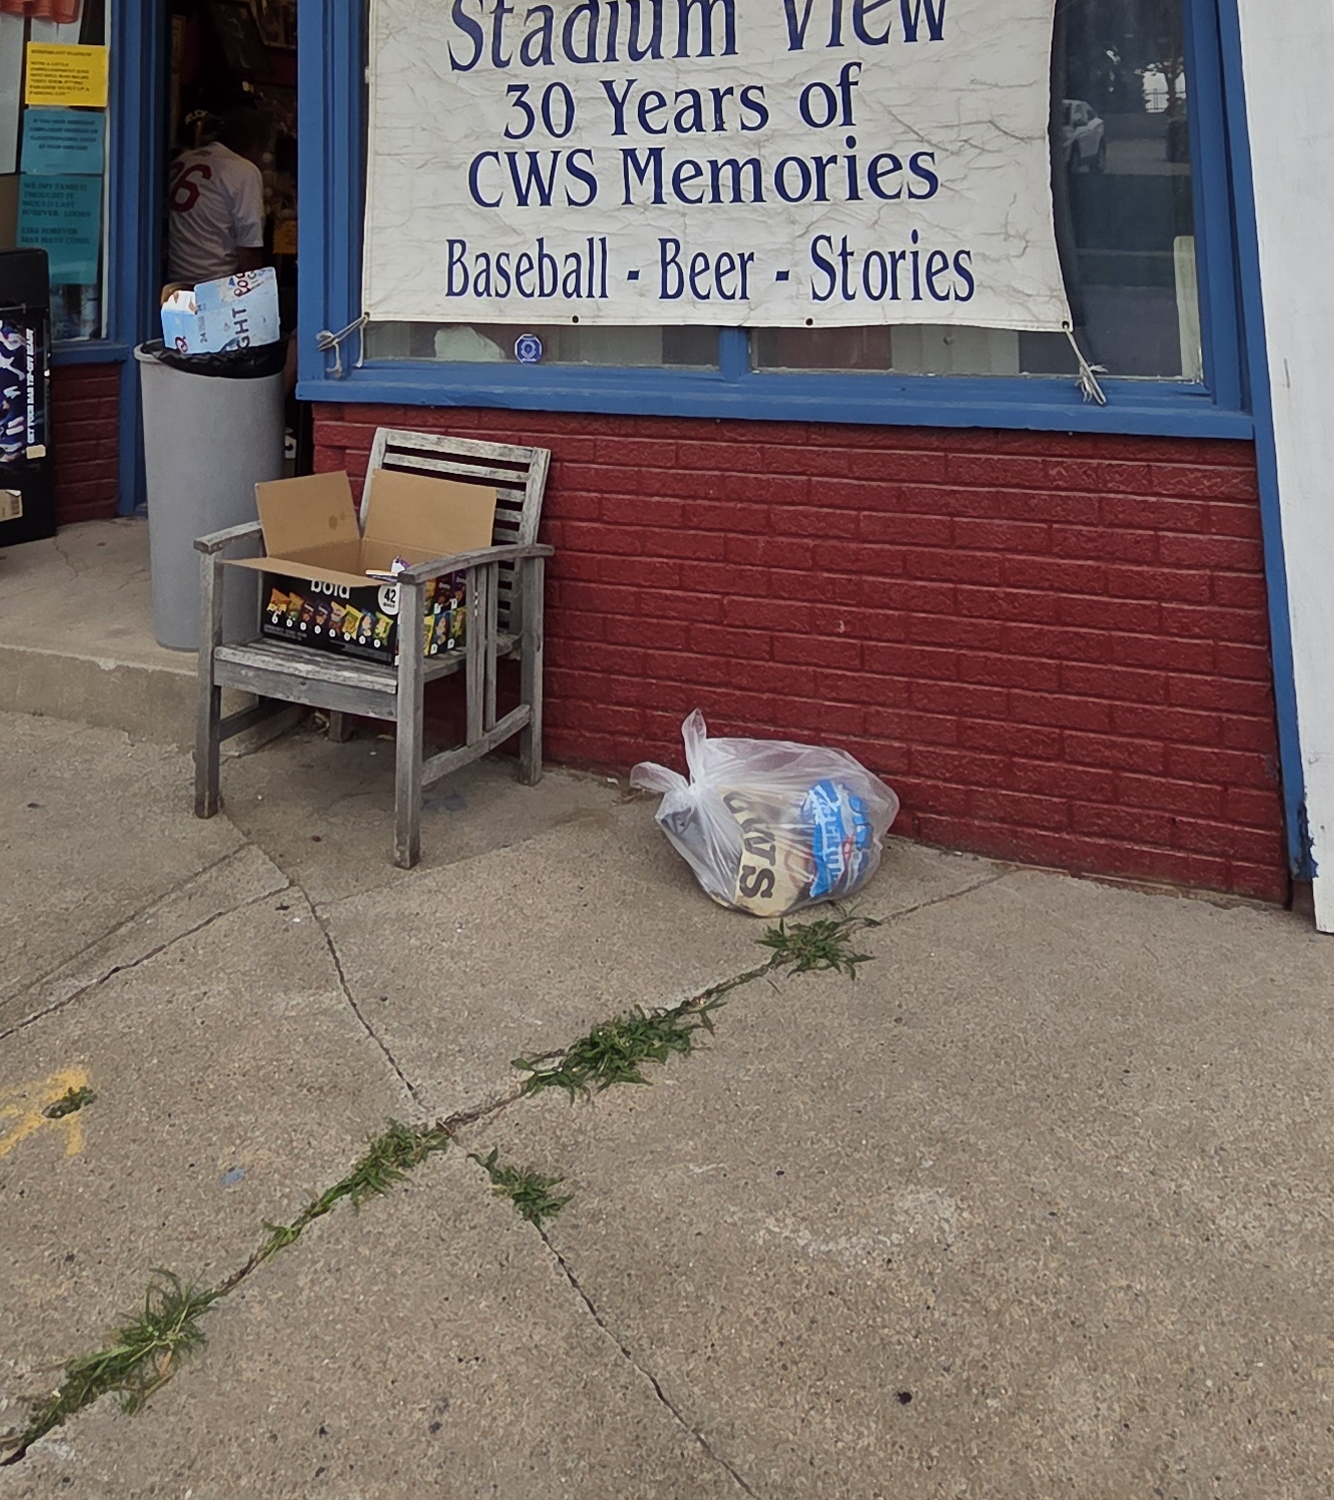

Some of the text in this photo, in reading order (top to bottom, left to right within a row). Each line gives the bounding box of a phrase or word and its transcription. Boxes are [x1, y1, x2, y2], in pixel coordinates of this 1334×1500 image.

[504, 61, 863, 140] 30 Years of
[469, 135, 940, 208] CWS Memories
[445, 237, 610, 299] Baseball
[659, 237, 755, 301] Beer
[811, 229, 975, 302] Stories
[232, 308, 250, 349] GHT
[384, 588, 396, 604] 42
